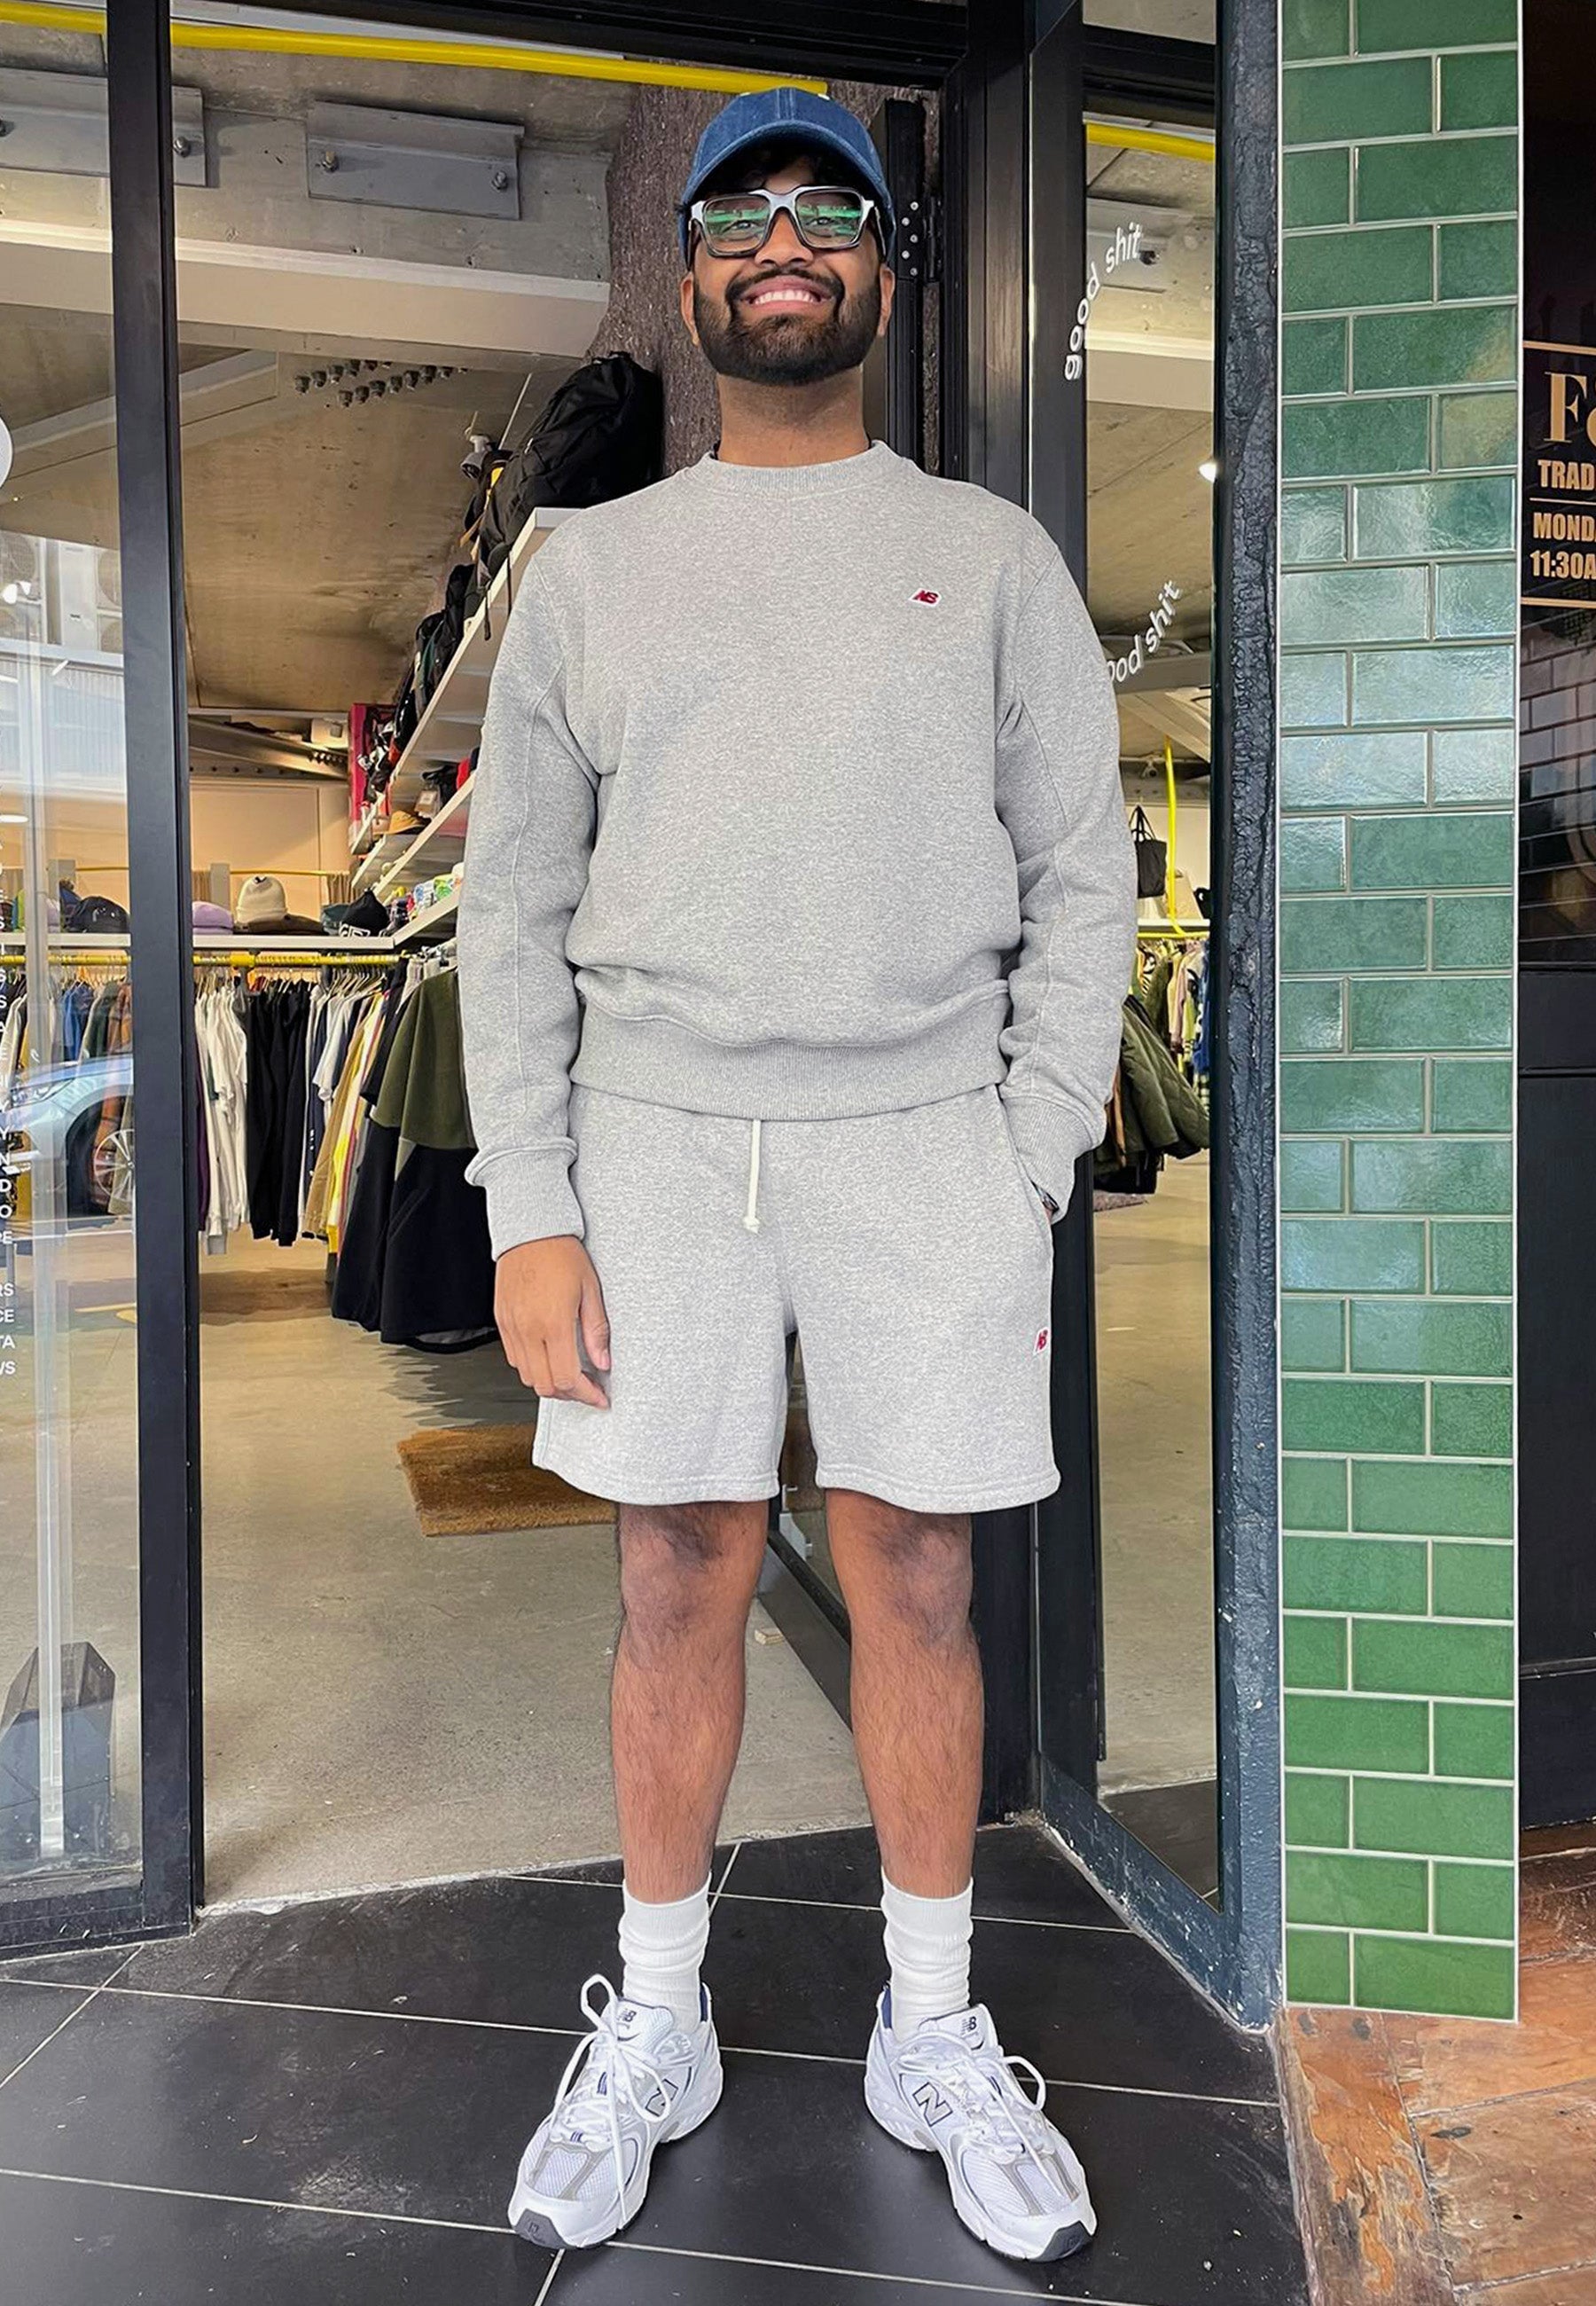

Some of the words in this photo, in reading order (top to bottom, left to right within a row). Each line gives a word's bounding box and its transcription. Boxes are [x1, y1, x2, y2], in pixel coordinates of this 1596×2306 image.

[1065, 262, 1101, 380] good
[1106, 222, 1143, 273] shit
[1533, 512, 1596, 542] MOND
[1107, 634, 1144, 682] ood
[1146, 580, 1181, 653] shit
